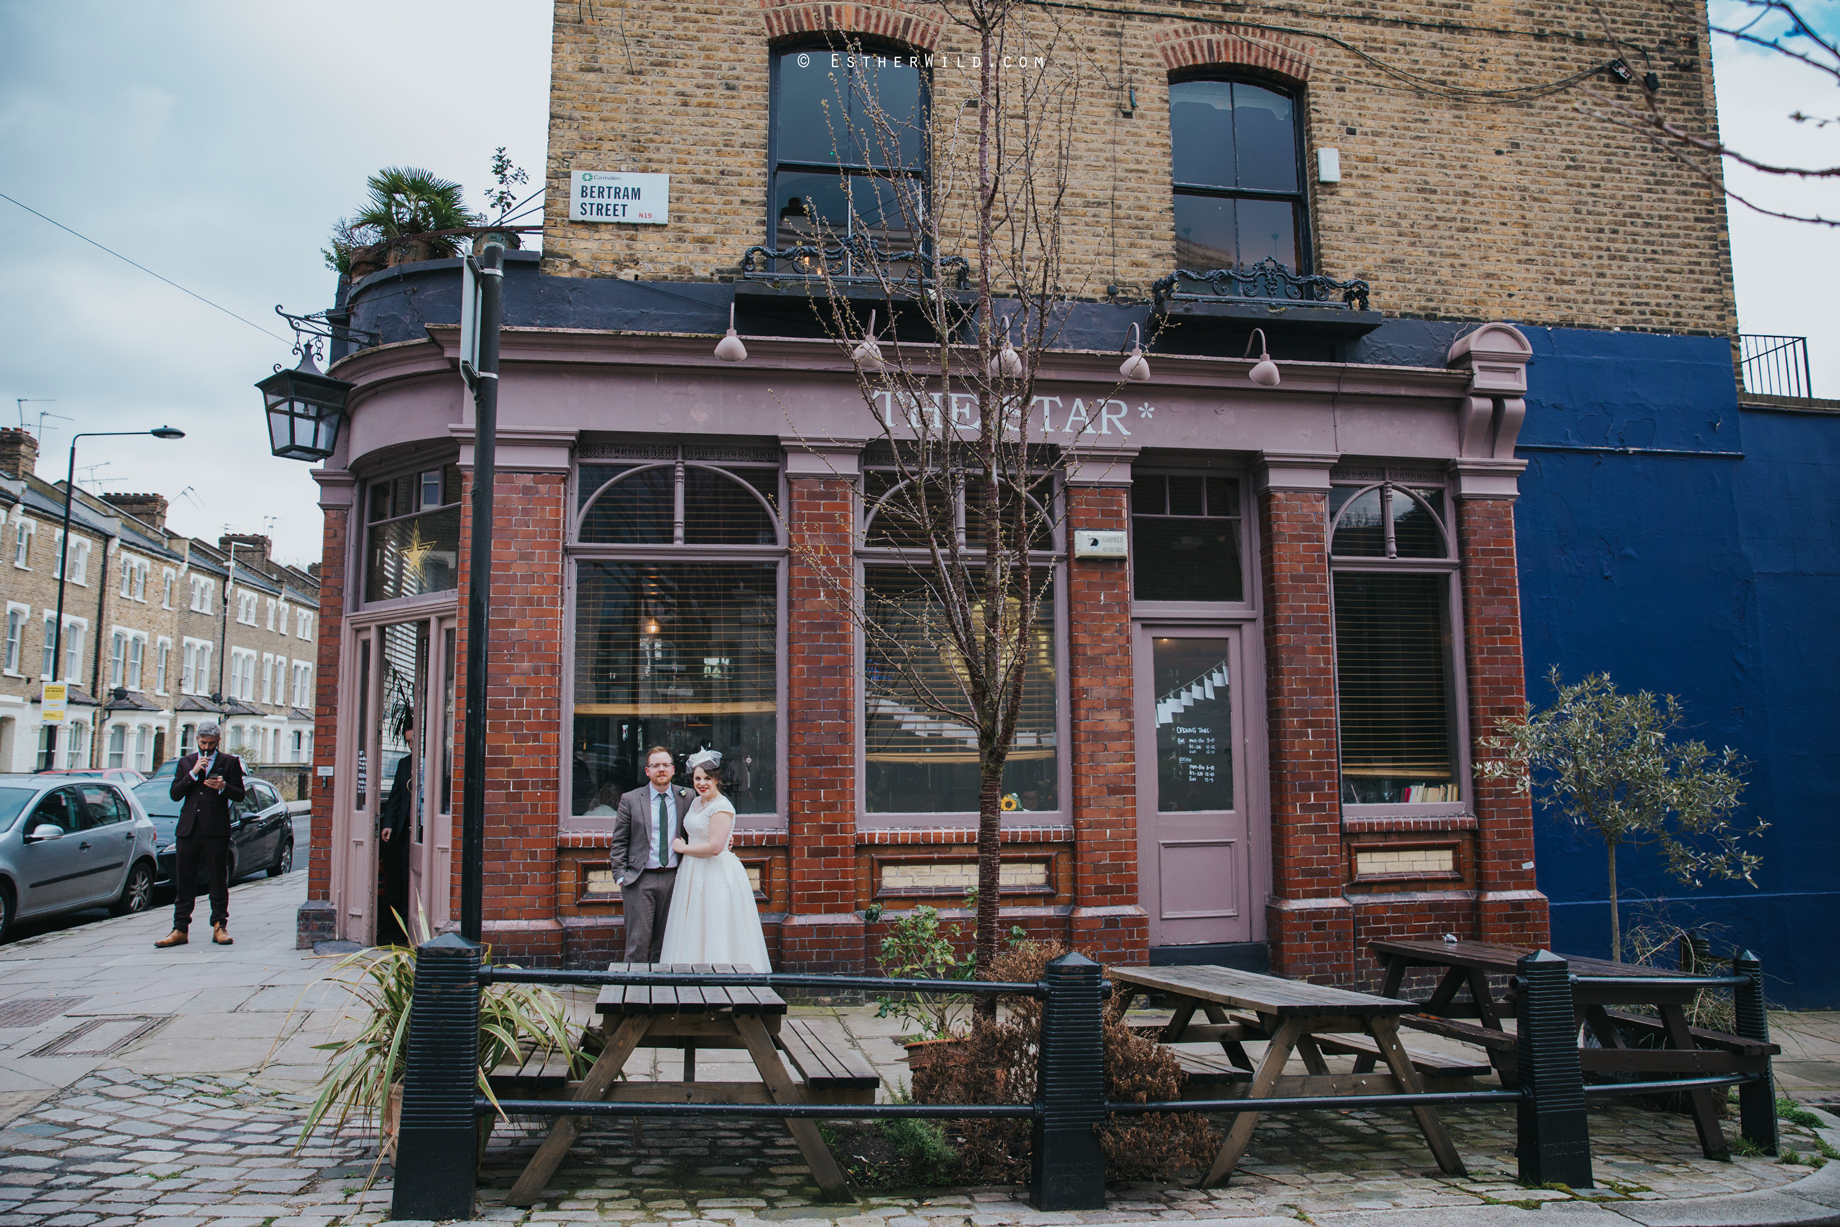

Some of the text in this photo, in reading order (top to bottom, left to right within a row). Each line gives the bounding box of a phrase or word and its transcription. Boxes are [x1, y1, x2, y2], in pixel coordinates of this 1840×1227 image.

[580, 185, 641, 200] BERTRAM
[580, 202, 628, 217] STREET
[872, 389, 1131, 436] THE STAR
